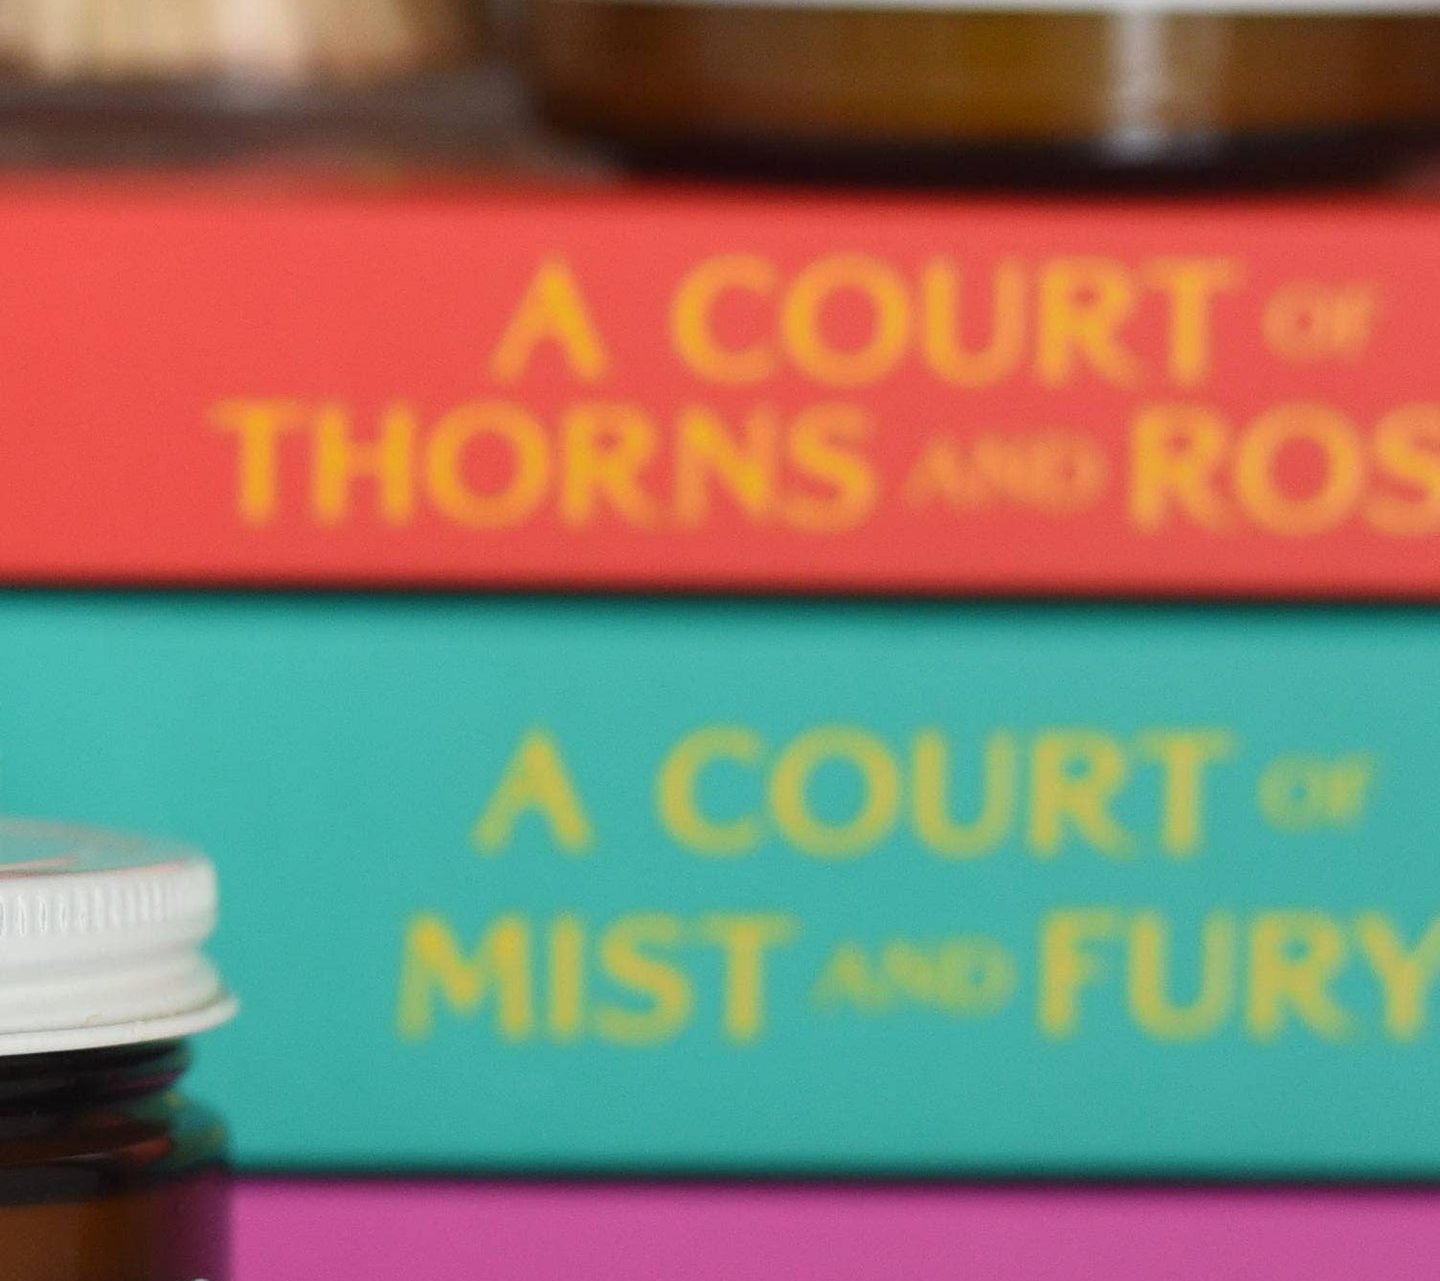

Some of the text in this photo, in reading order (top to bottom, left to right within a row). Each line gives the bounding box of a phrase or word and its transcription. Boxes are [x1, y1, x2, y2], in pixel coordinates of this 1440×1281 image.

[489, 254, 614, 387] A
[667, 252, 1249, 391] COURT
[210, 396, 880, 533] THORNS
[904, 431, 1110, 513] AND
[468, 724, 597, 859] A
[653, 722, 1242, 863] COURT
[394, 908, 801, 1047] MIST
[808, 936, 1019, 1018] AND
